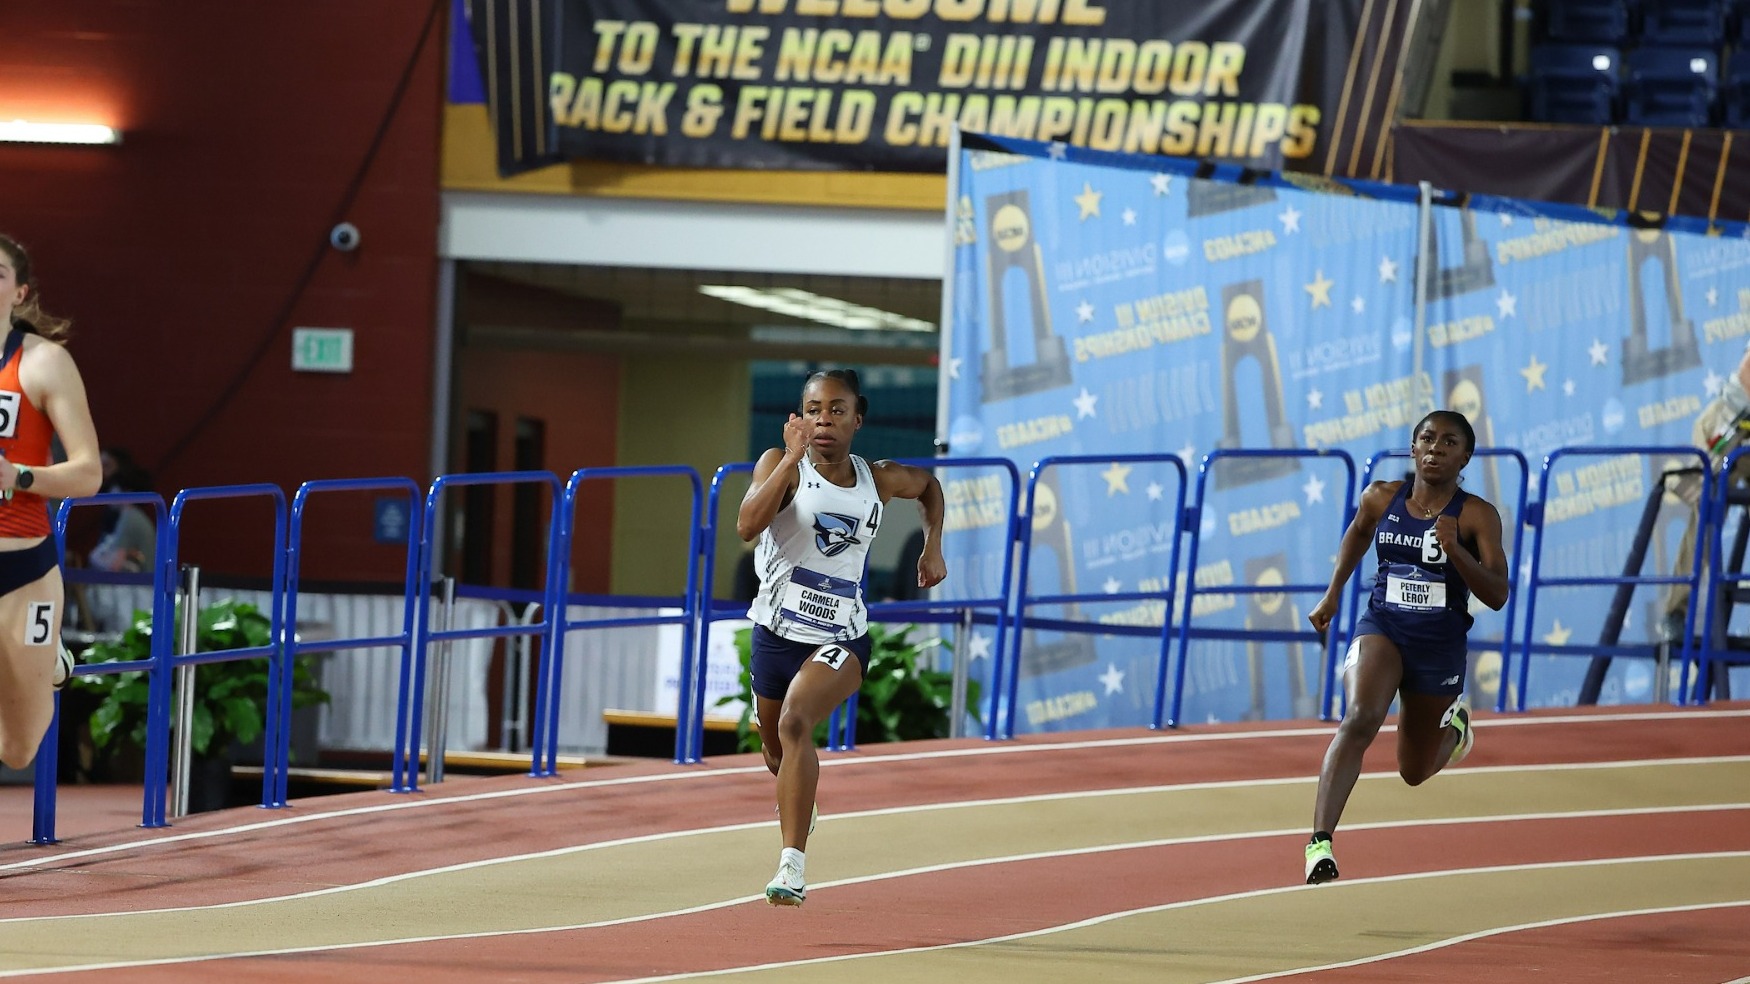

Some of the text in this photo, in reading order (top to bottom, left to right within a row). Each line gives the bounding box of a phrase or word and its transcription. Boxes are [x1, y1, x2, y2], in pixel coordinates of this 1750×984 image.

[592, 20, 659, 75] TO
[671, 24, 770, 80] THE
[938, 33, 1037, 89] DIII
[1040, 37, 1247, 98] INDOOR
[549, 71, 1322, 158] RACK & FIELD CHAMPIONSHIPS
[302, 335, 343, 364] EXIT
[0, 395, 13, 433] 5
[866, 502, 880, 536] 4
[1378, 531, 1423, 549] BRAND
[1427, 531, 1443, 562] 3
[800, 589, 840, 609] CARMELA
[1400, 581, 1430, 593] PETERLY
[1401, 592, 1430, 604] LEROY
[33, 604, 51, 645] 5
[798, 600, 837, 621] WOODS
[820, 646, 842, 665] 4
